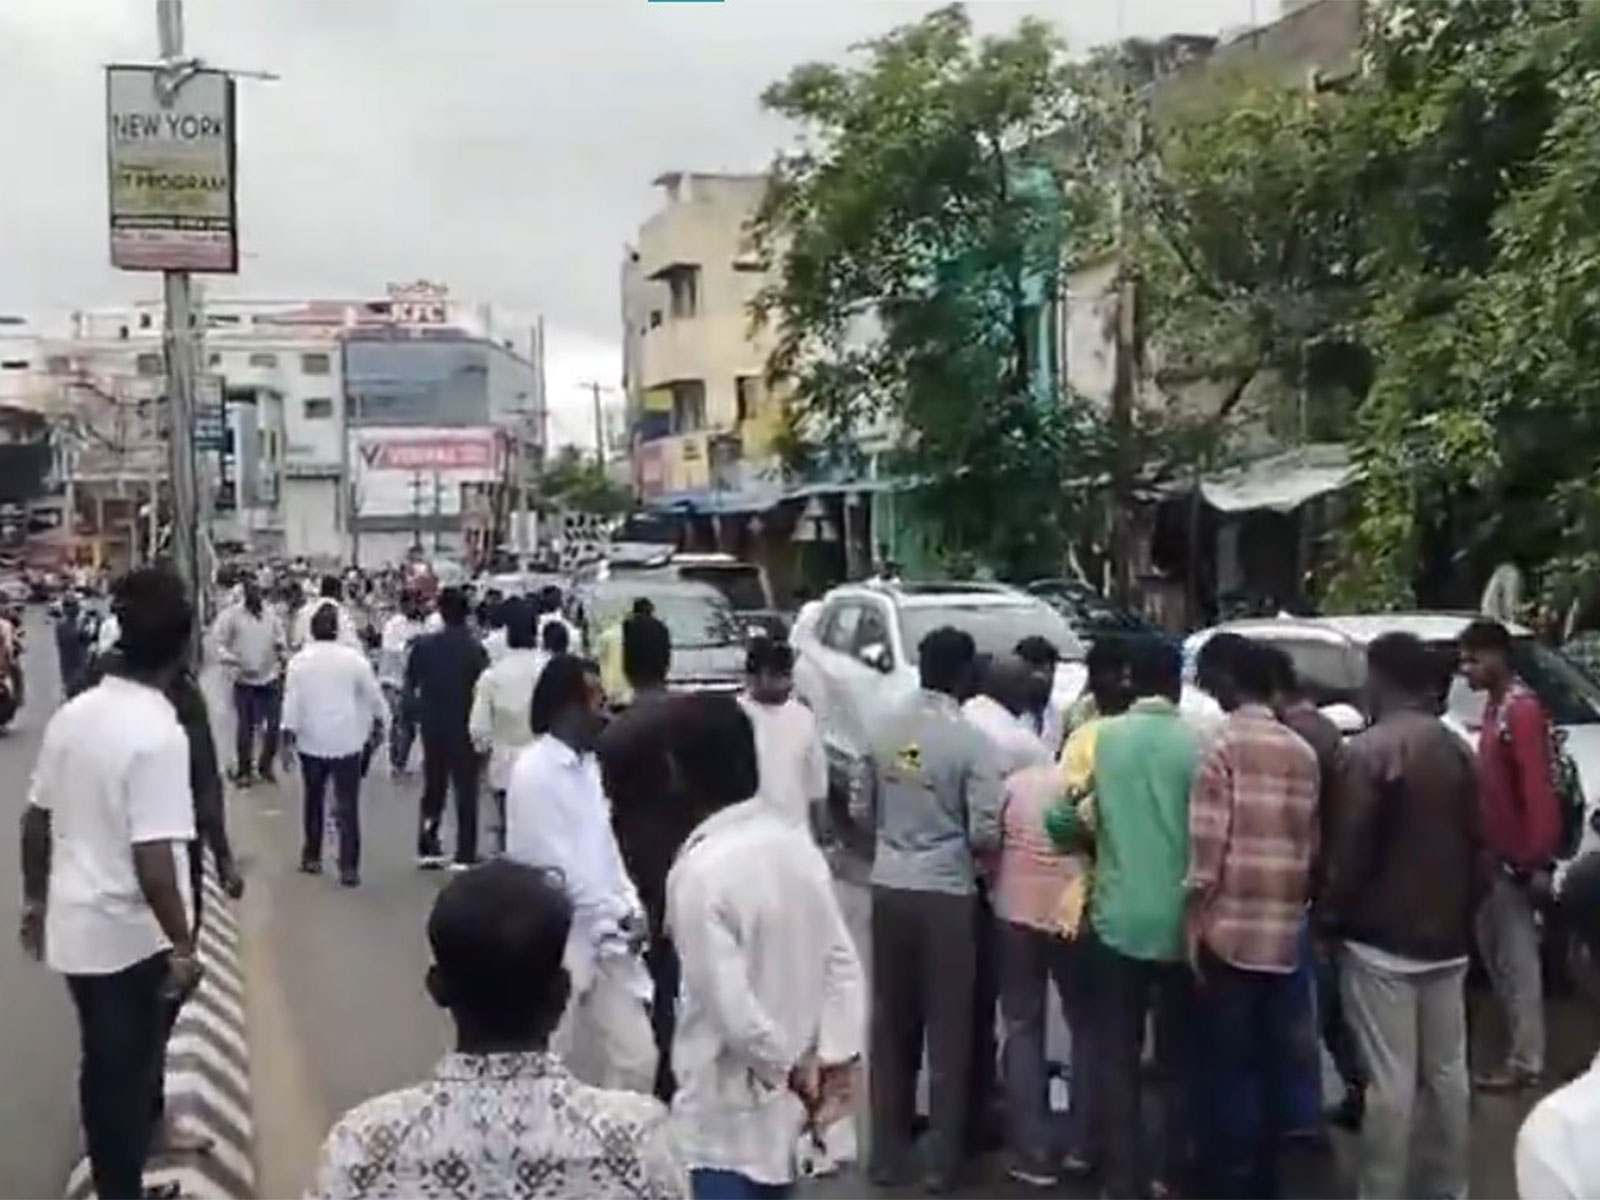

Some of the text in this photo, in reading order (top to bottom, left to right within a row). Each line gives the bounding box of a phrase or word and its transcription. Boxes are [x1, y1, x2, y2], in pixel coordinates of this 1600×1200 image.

[113, 113, 223, 139] NEW YORK
[135, 174, 226, 191] PROGRAM
